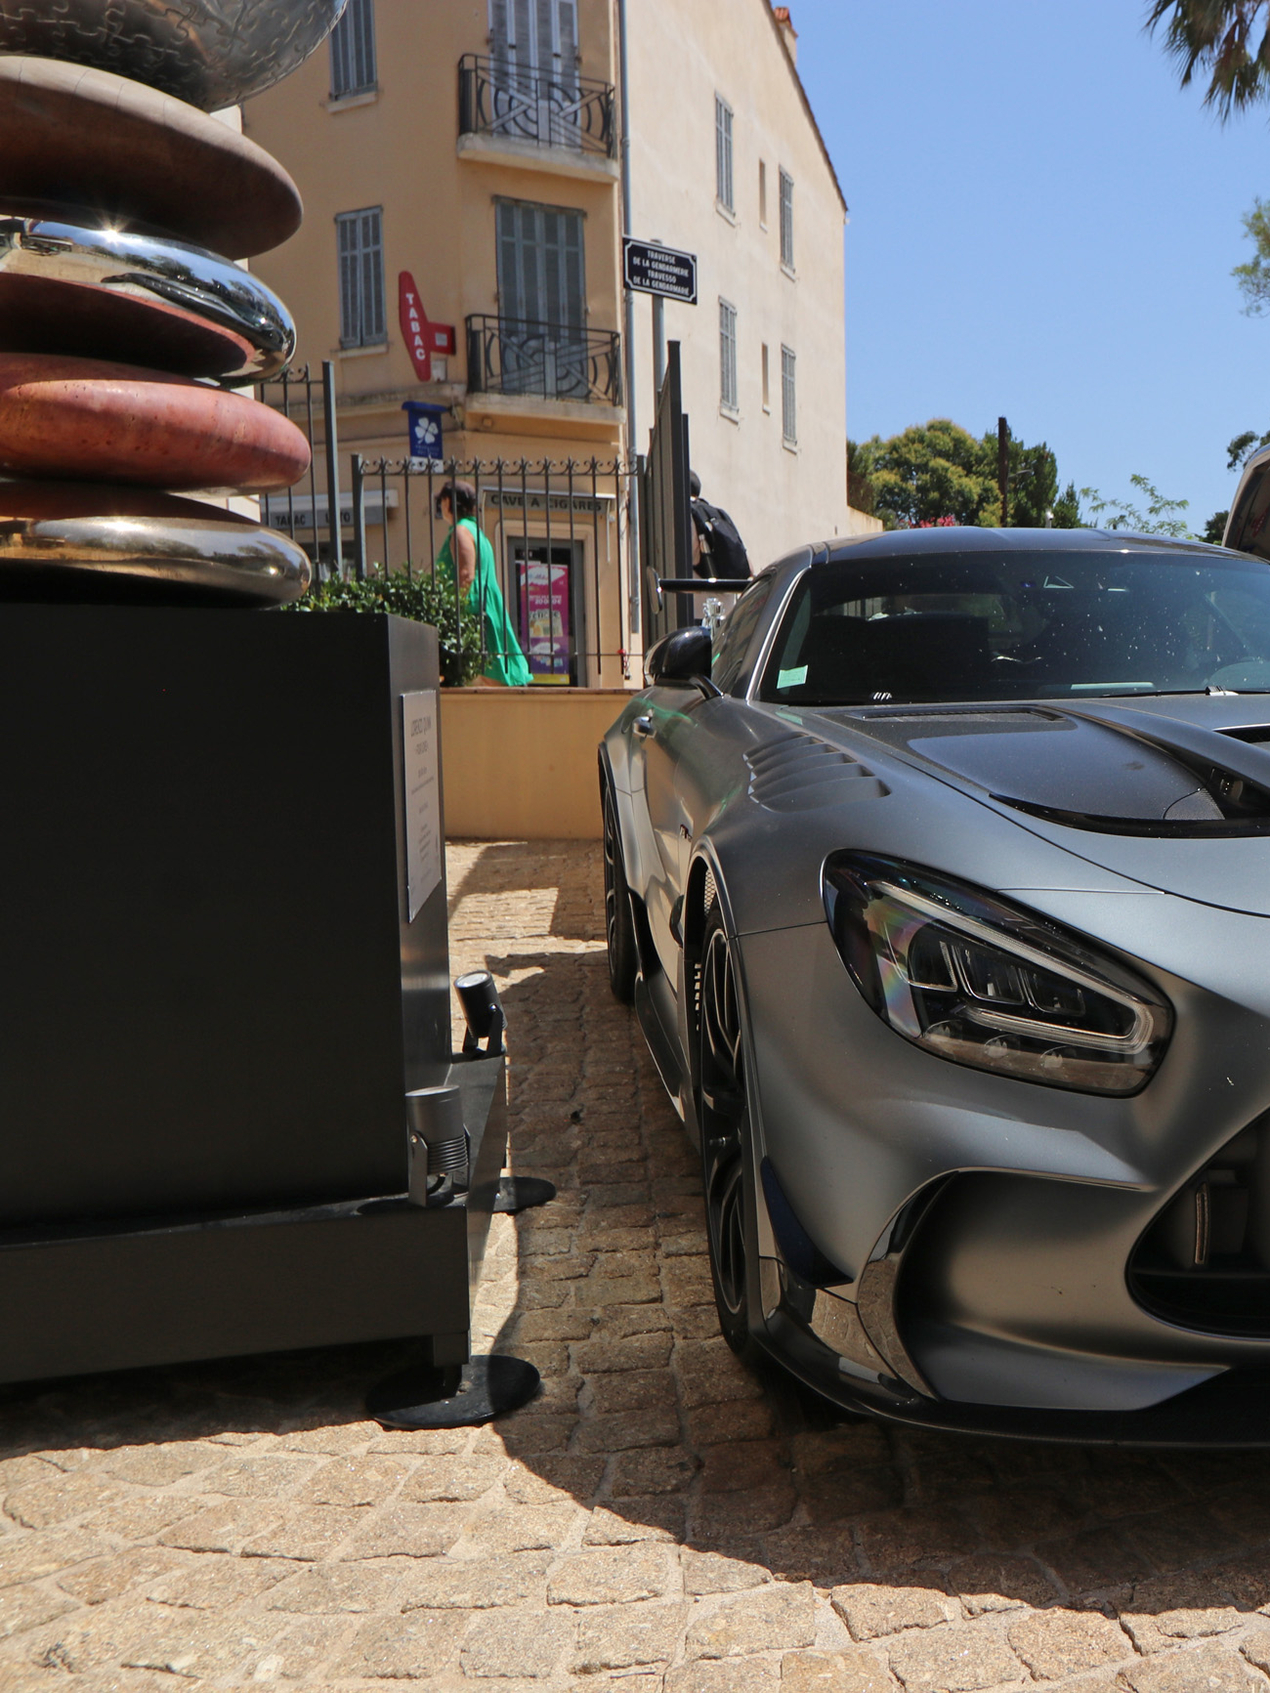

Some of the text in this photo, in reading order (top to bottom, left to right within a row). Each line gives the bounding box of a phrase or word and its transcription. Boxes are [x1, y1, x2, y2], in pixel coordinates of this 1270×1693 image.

[647, 250, 676, 265] TRAVERSE
[633, 256, 689, 278] DE LA GENDARMERIE
[633, 276, 641, 285] DE
[642, 278, 650, 287] LA
[647, 269, 677, 285] TRAVESSO
[405, 293, 426, 360] TABAC
[491, 494, 524, 506] CAVE
